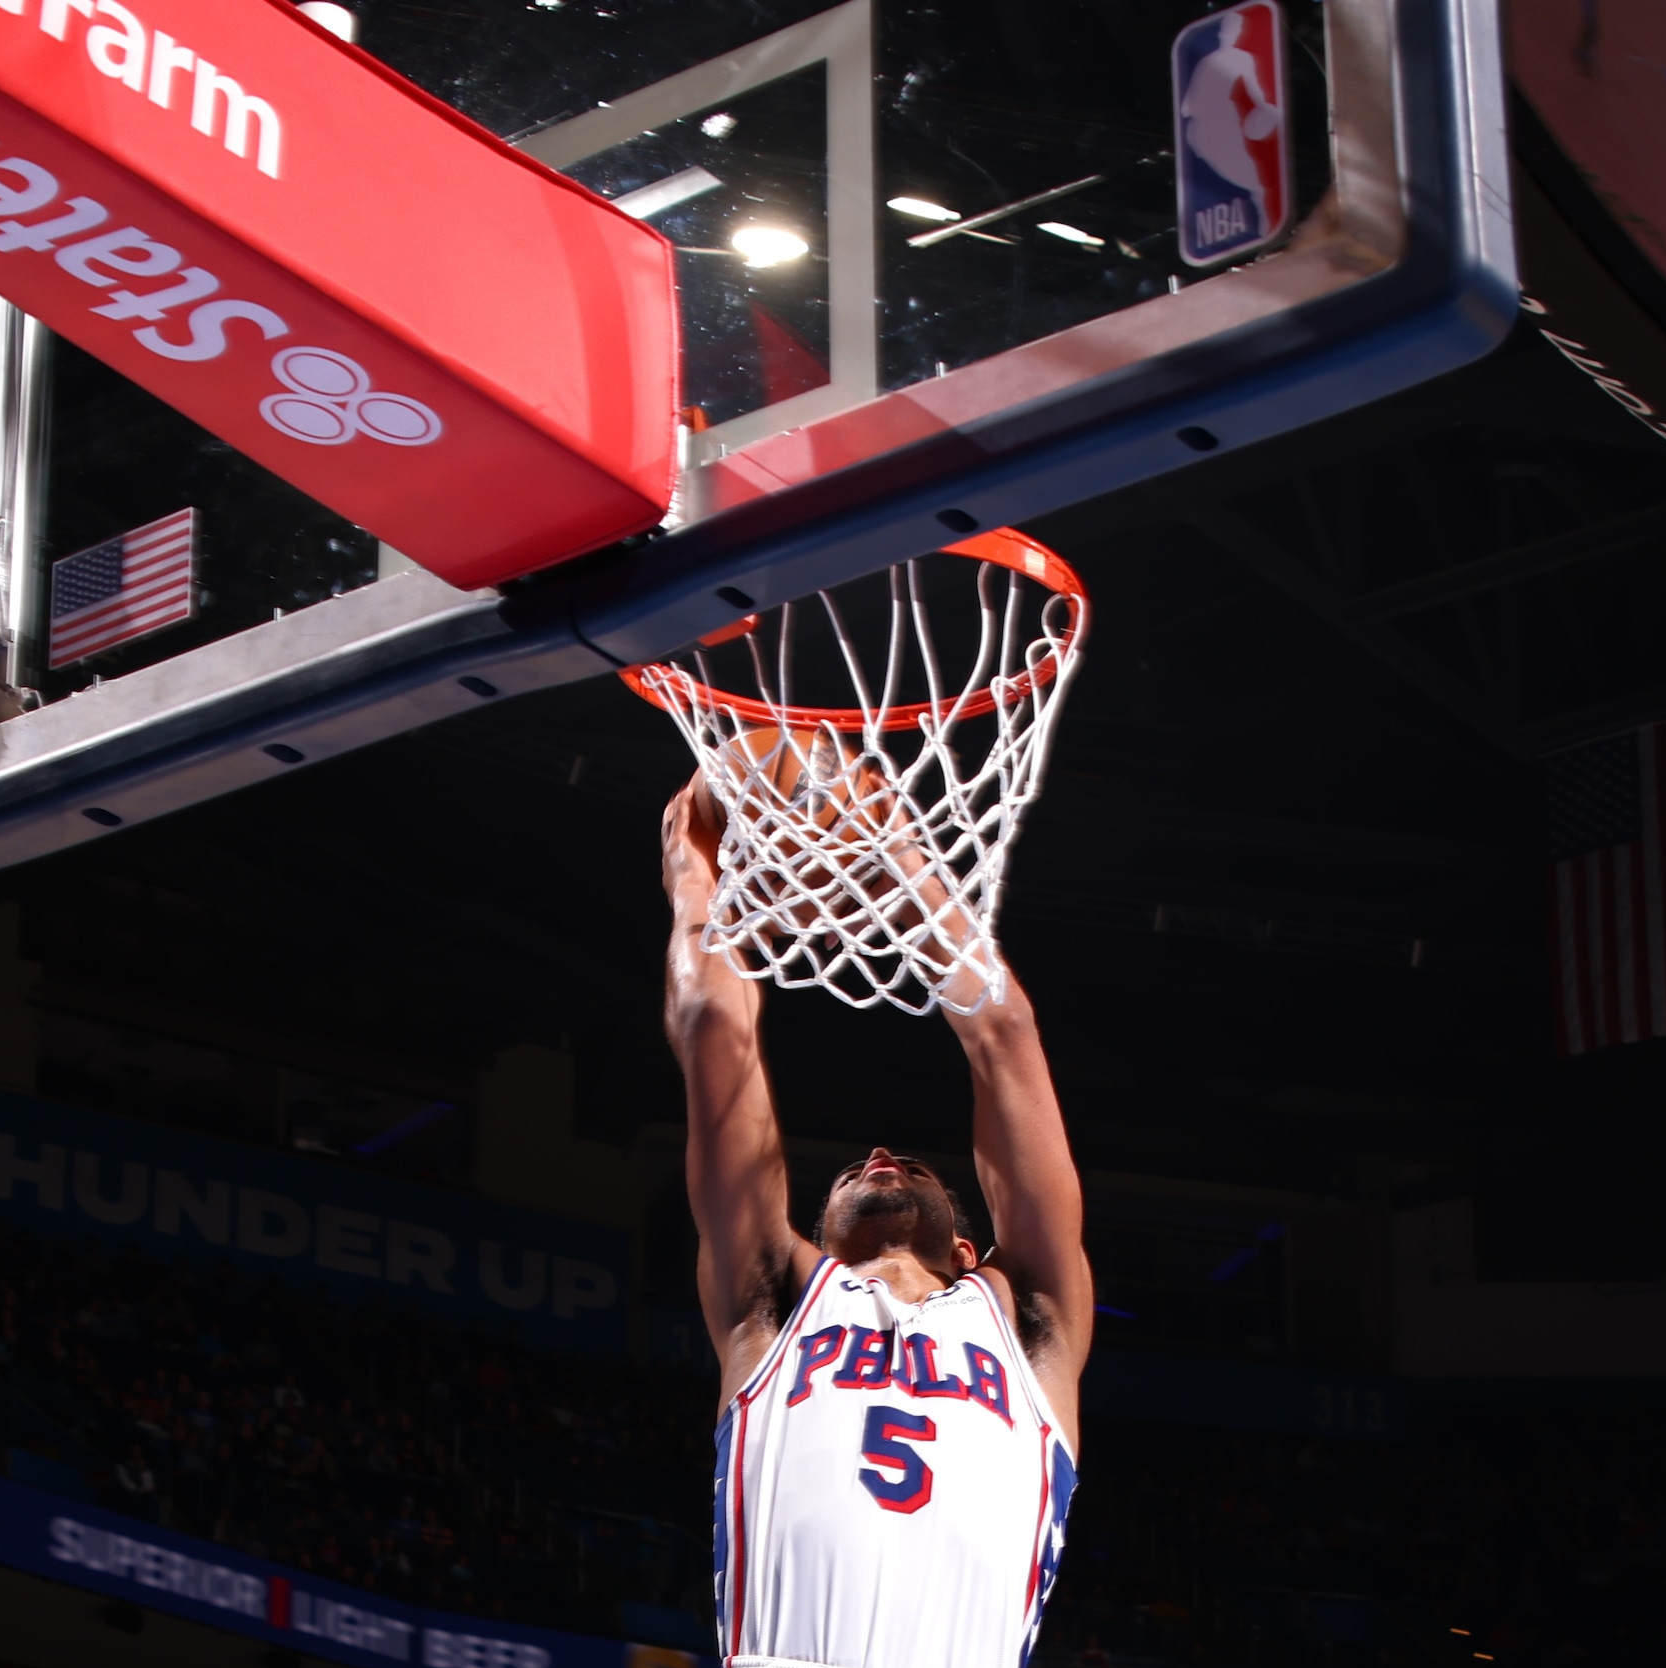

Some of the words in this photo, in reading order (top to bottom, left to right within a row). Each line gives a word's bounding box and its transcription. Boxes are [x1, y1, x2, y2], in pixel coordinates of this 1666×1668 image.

[1196, 198, 1247, 249] NBA
[478, 1238, 618, 1320] UP
[786, 1324, 1013, 1428] PHILA
[859, 1405, 935, 1514] 5
[49, 1515, 268, 1619] SUPERIOR
[290, 1593, 419, 1662] LIGHT
